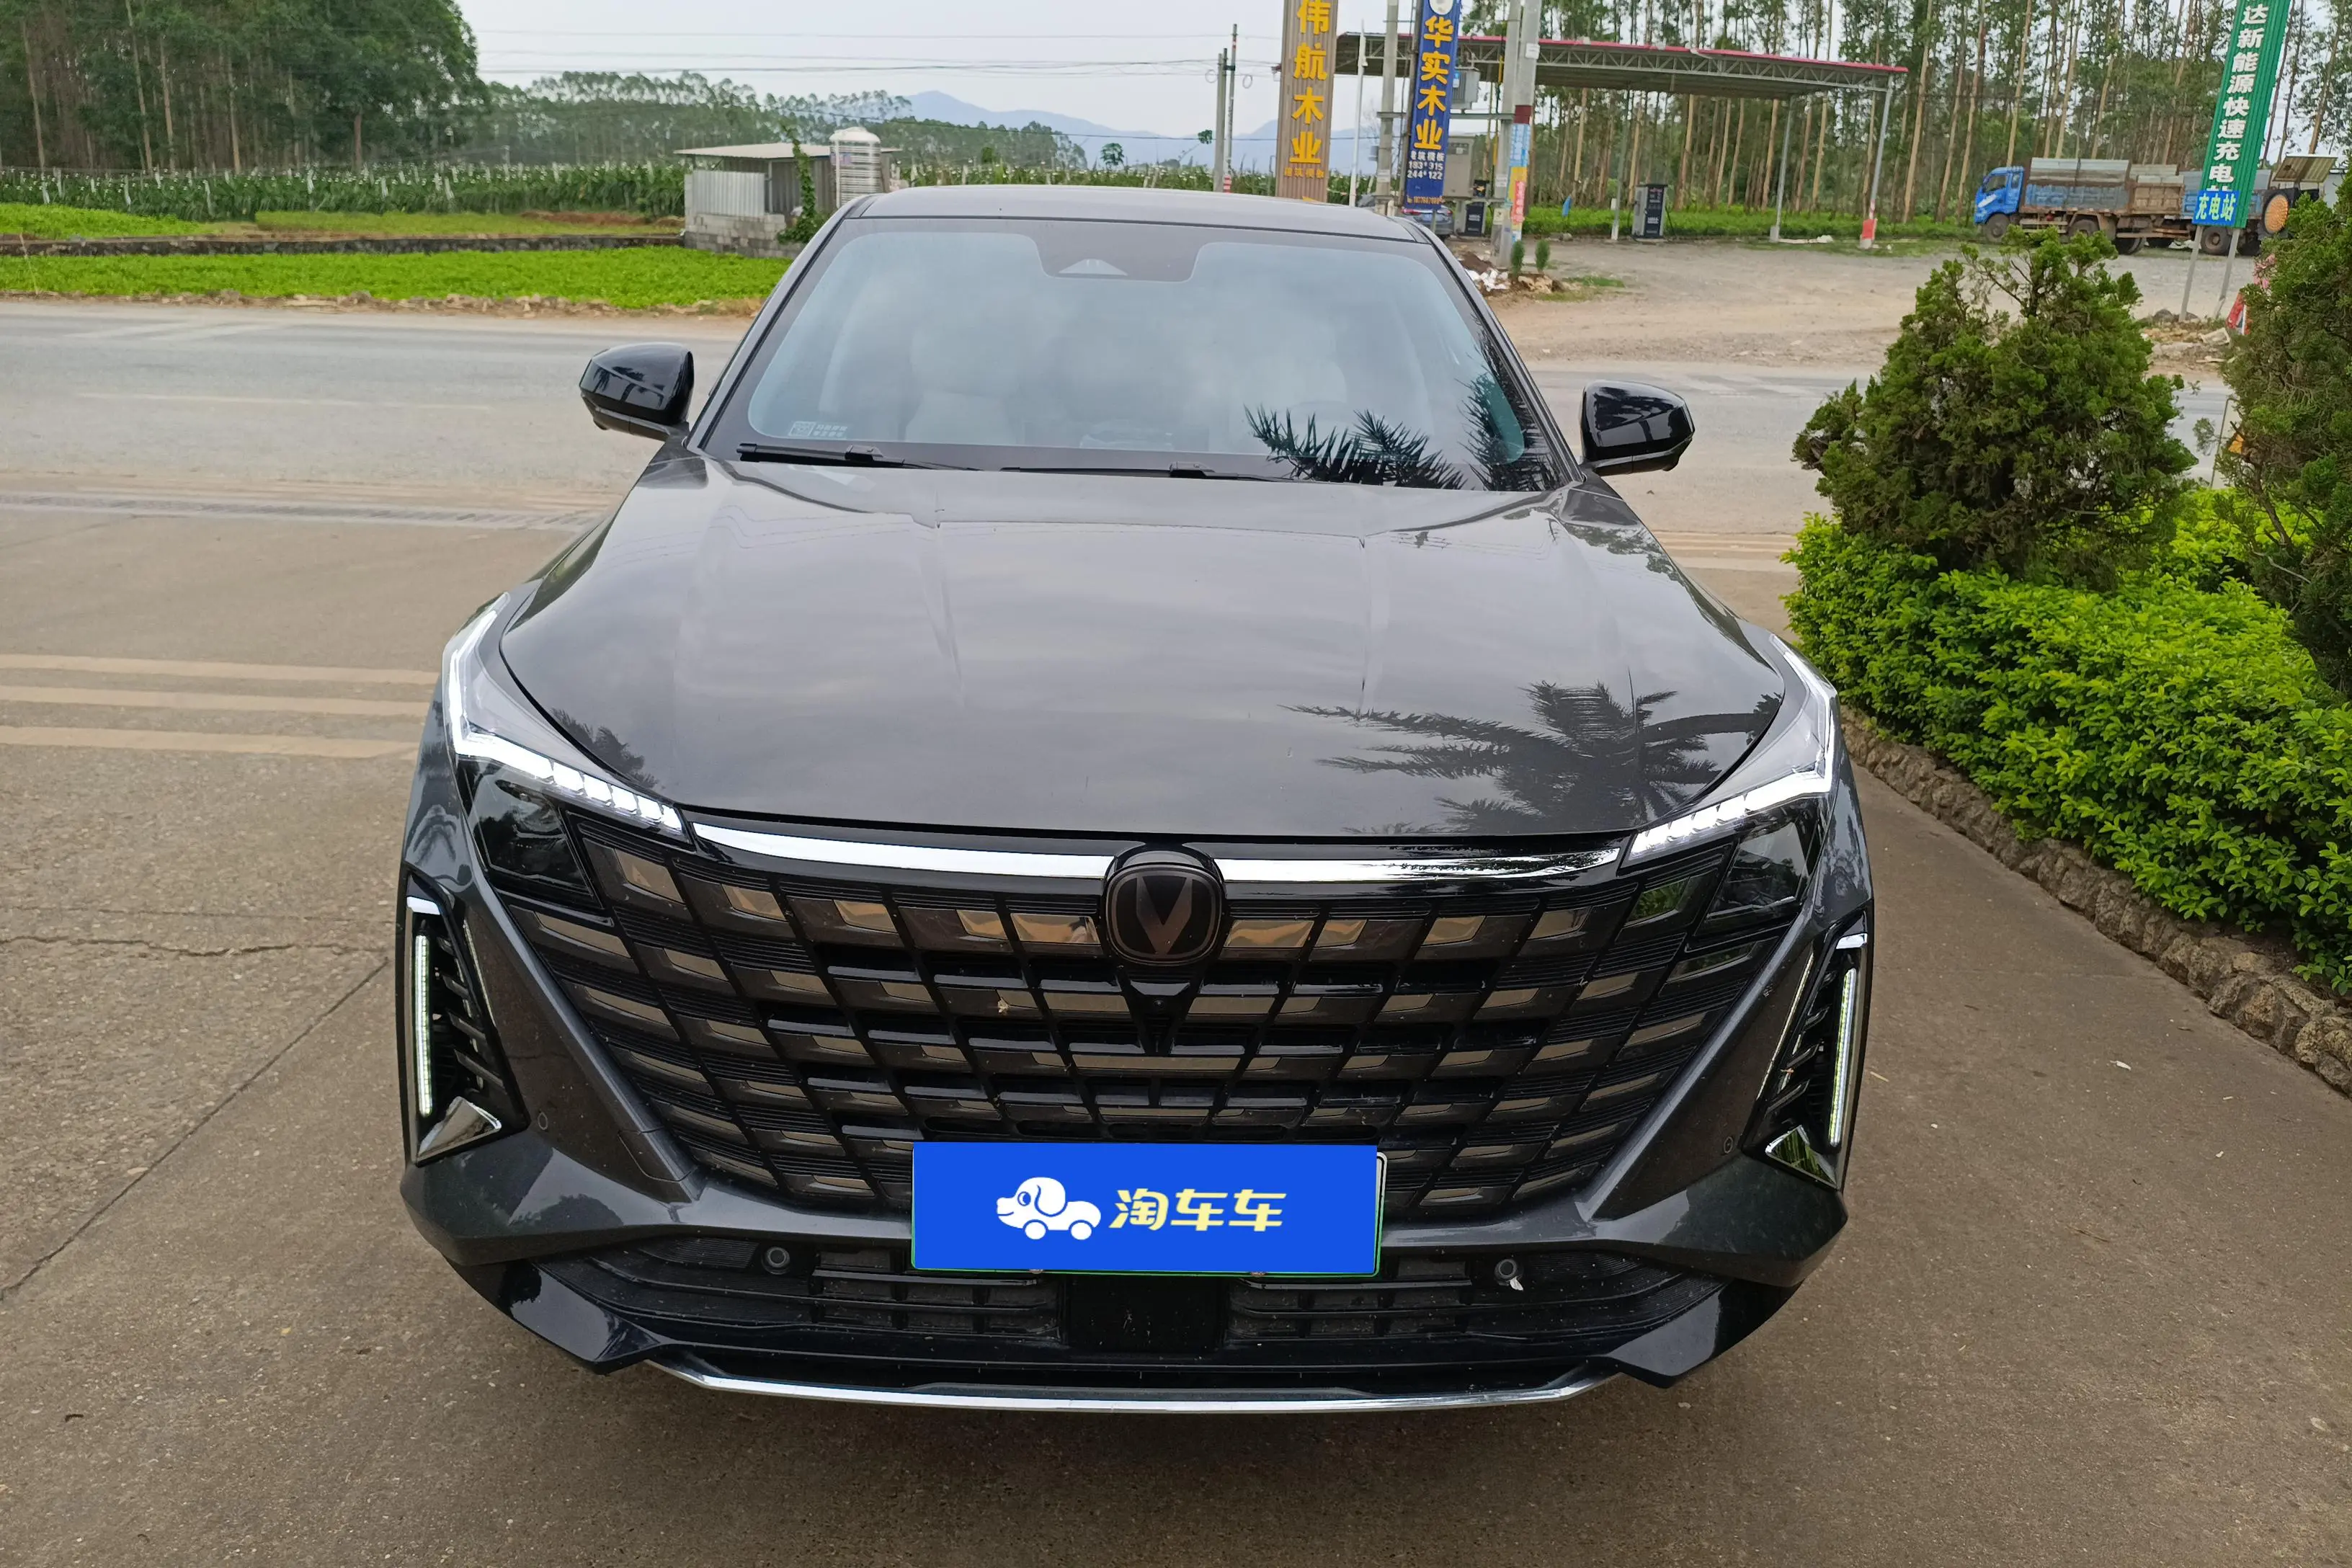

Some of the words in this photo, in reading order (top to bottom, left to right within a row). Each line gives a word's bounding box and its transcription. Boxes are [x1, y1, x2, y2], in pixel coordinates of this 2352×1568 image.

[1289, 0, 1331, 164] 伟航木业
[1414, 15, 1453, 150] 华实木业
[2206, 4, 2268, 191] 达新能源快速充电
[2196, 192, 2237, 221] 充电站
